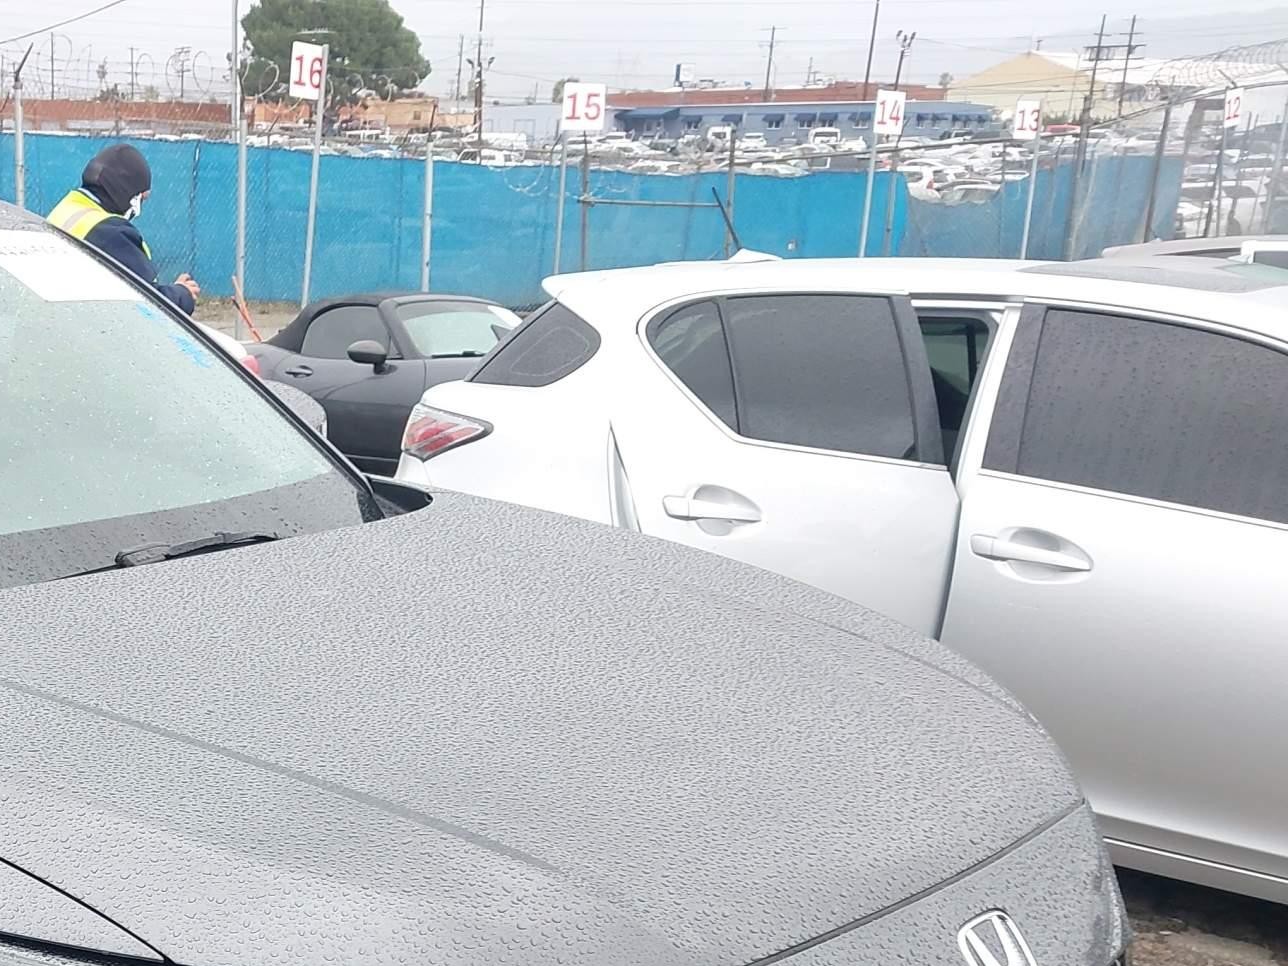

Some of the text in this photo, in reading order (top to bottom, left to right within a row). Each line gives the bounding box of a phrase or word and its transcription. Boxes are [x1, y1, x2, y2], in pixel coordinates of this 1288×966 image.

[293, 54, 325, 90] 16
[564, 92, 601, 121] 15
[876, 99, 902, 127] 14
[1015, 108, 1041, 132] 13
[1225, 95, 1241, 121] 12
